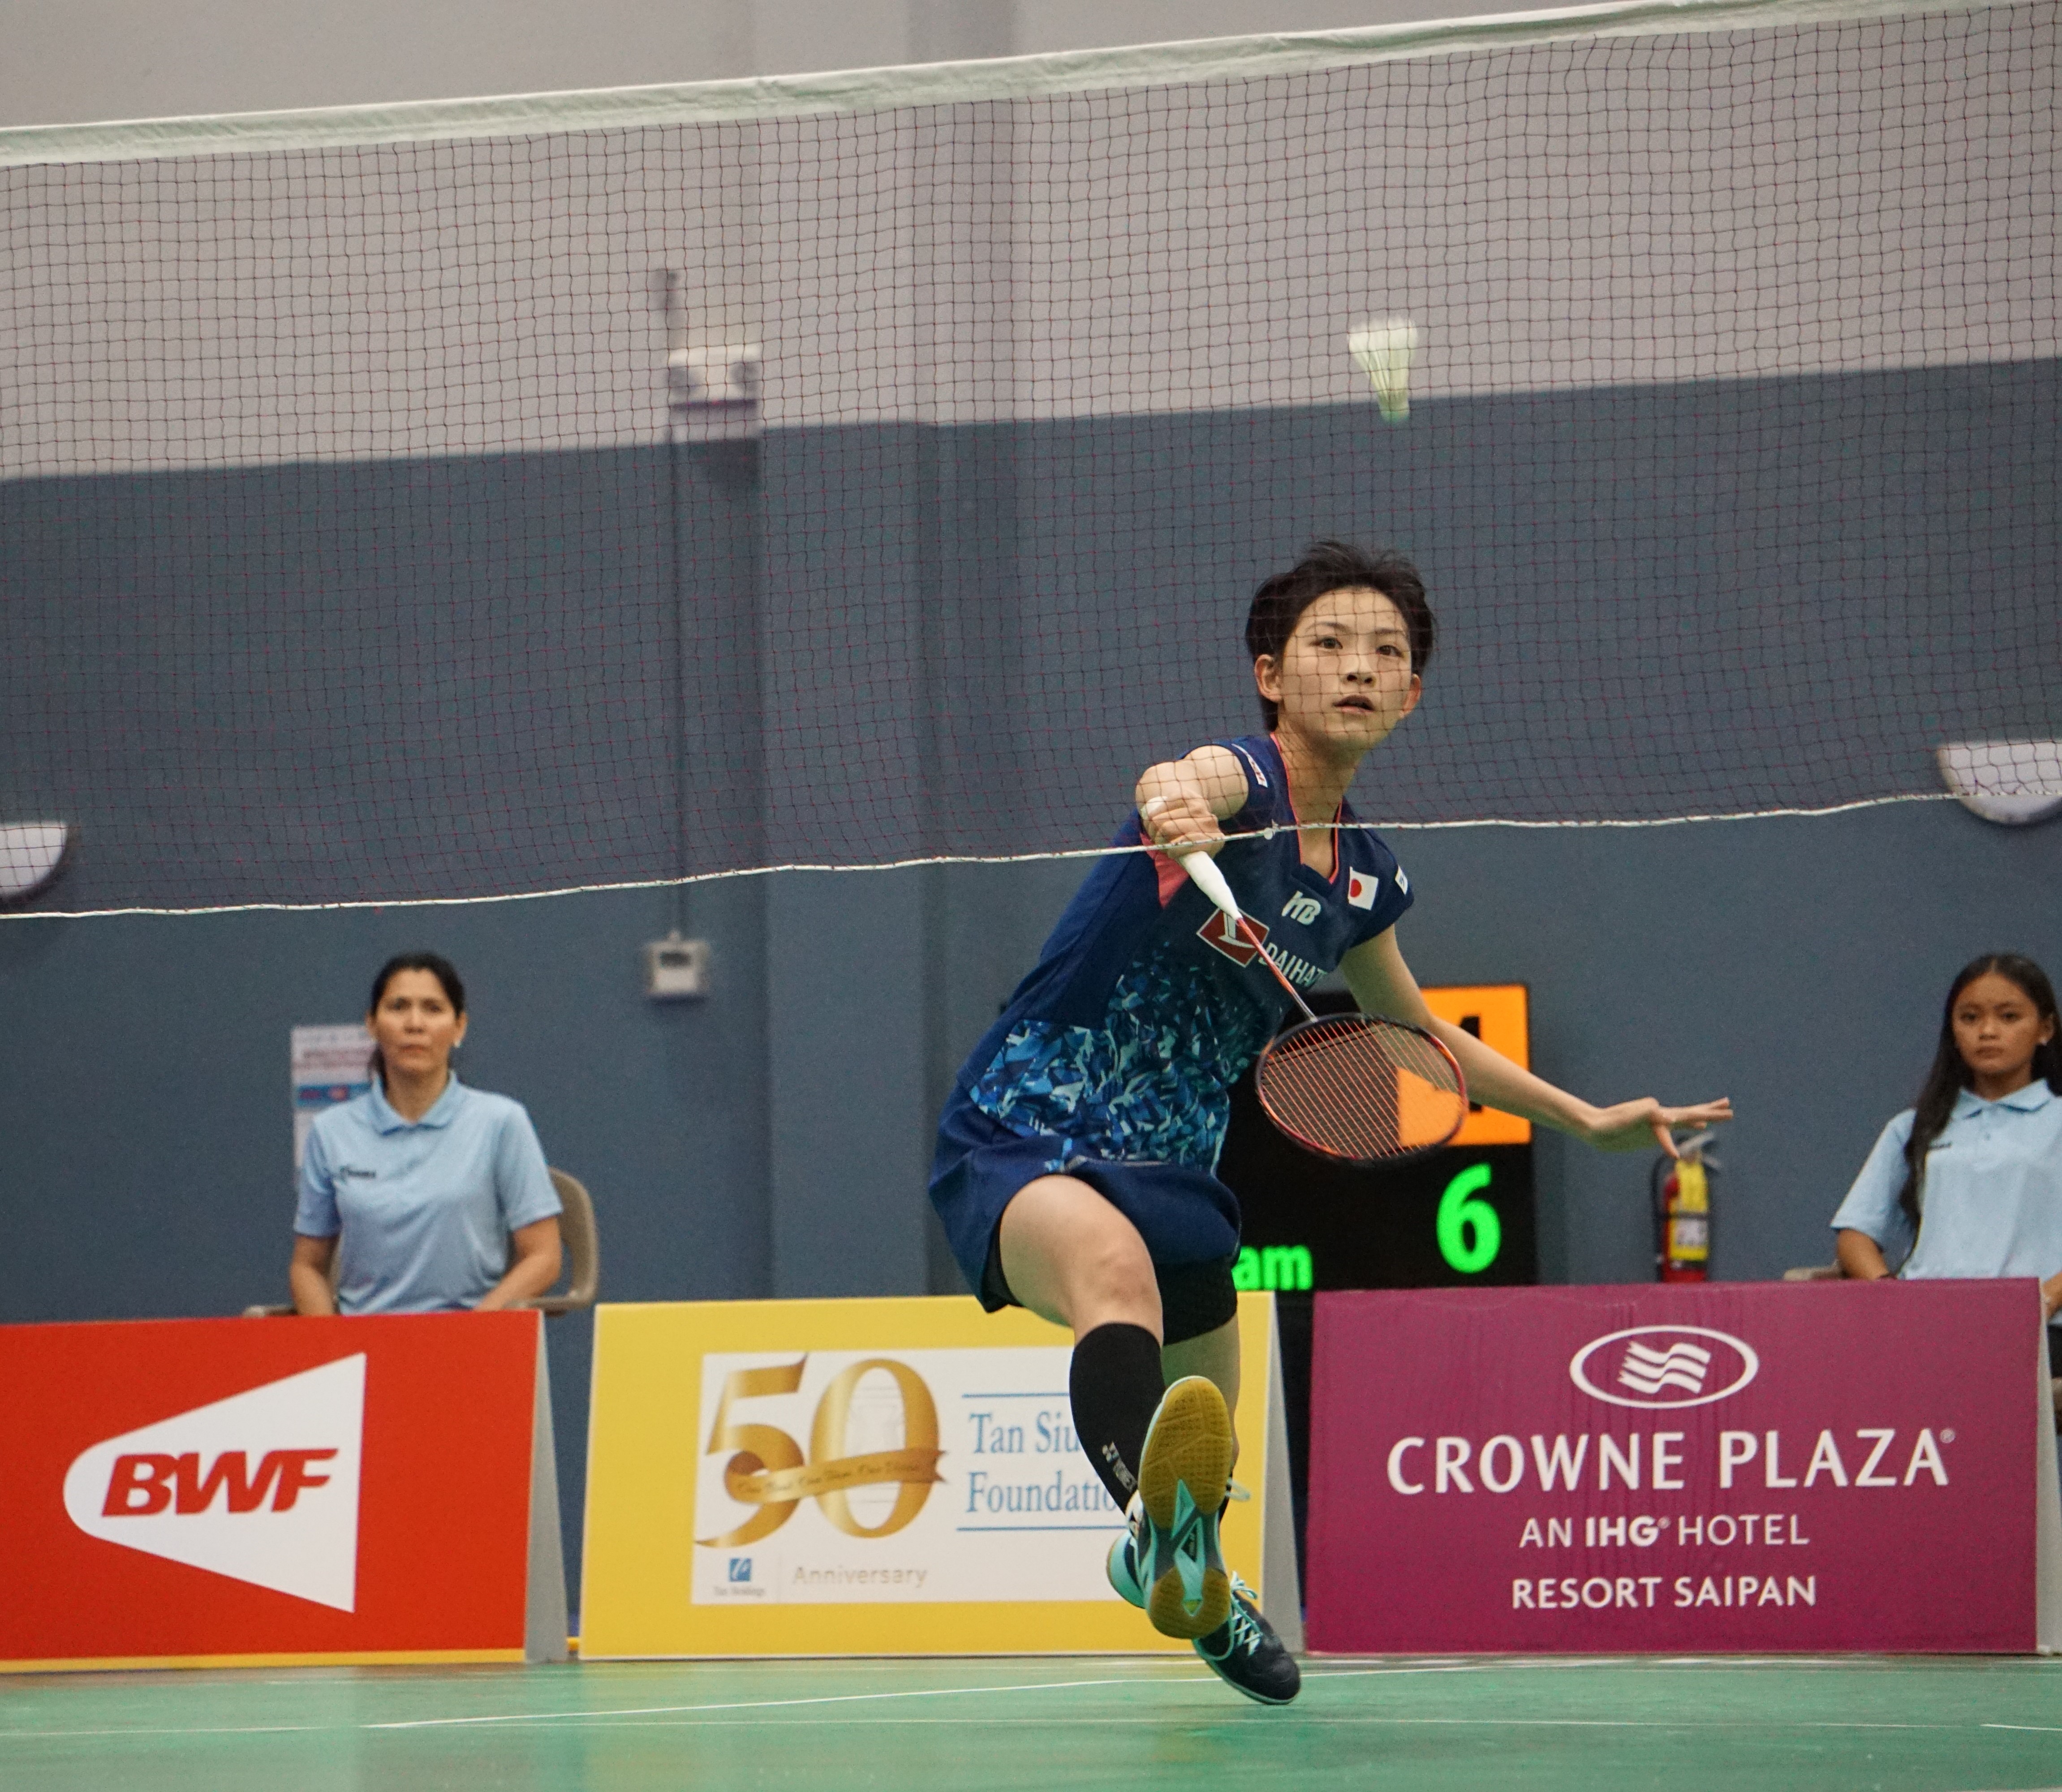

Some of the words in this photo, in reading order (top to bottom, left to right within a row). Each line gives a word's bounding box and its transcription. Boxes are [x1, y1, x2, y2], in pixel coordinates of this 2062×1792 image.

[1437, 1164, 1501, 1273] 6
[694, 1352, 943, 1548] 50
[969, 1412, 1025, 1454] Tan
[1035, 1411, 1080, 1453] Siu
[101, 1448, 338, 1517] BWF
[1387, 1431, 1684, 1495] CROWNE
[1519, 1517, 1572, 1548] AN
[1678, 1514, 1810, 1546] HOTEL
[792, 1566, 927, 1588] Anniversary
[1512, 1577, 1662, 1609] RESORT
[1674, 1575, 1817, 1607] SAIPAN
